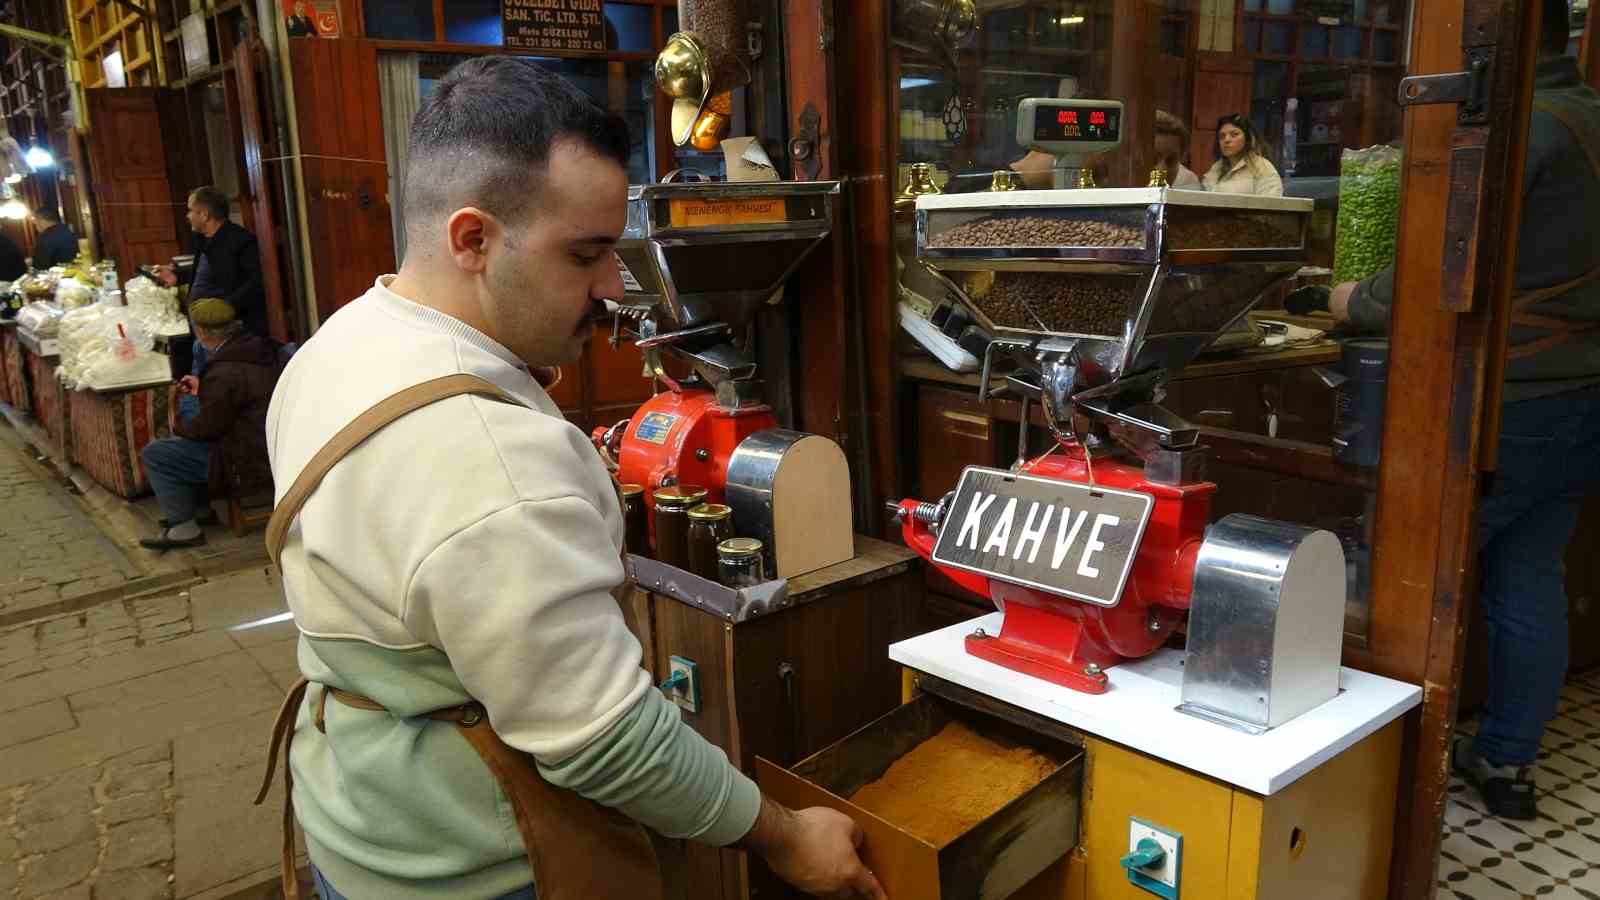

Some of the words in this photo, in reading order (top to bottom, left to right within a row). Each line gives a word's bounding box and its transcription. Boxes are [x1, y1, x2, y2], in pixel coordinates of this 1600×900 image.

[504, 8, 531, 21] SAN.
[556, 11, 579, 24] LTD.
[955, 491, 1120, 578] KAHVE
